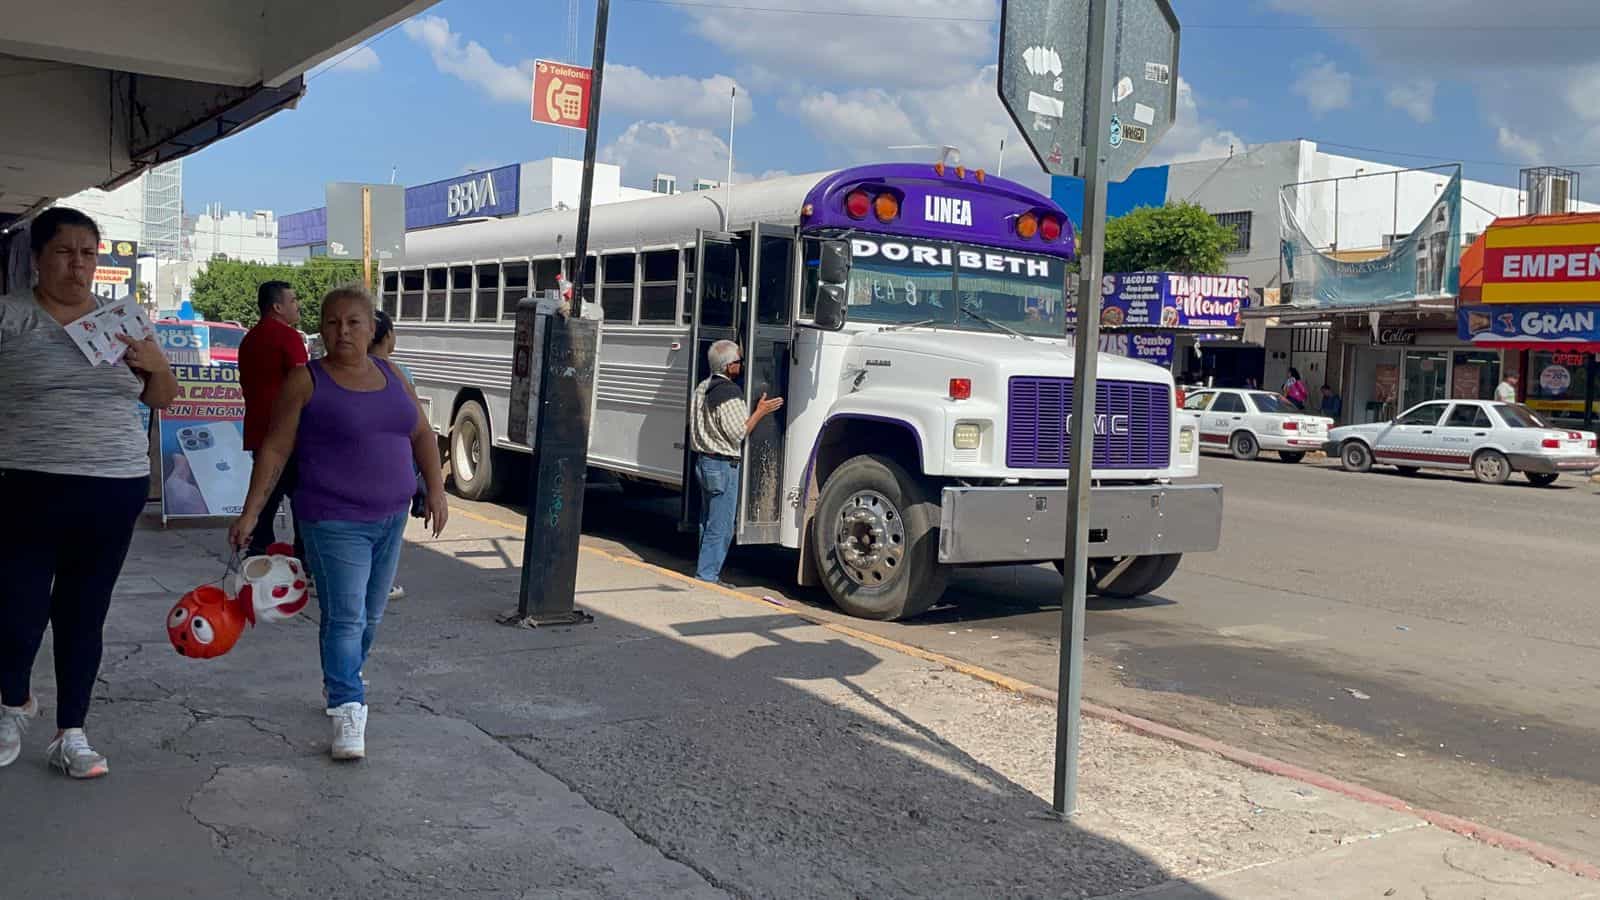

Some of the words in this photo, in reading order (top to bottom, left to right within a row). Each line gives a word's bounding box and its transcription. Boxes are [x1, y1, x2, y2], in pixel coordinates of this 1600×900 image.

[447, 172, 496, 217] BBVA
[925, 195, 972, 226] LINEA
[1122, 275, 1145, 285] TACOS
[1168, 275, 1248, 298] TAQUIZAS
[1183, 294, 1233, 317] Memo
[1520, 311, 1594, 335] GRAN
[1133, 334, 1172, 346] Combo
[1136, 346, 1168, 356] Torta
[1552, 353, 1584, 366] OPEN
[171, 366, 240, 381] ELEFO
[168, 404, 192, 415] SIN
